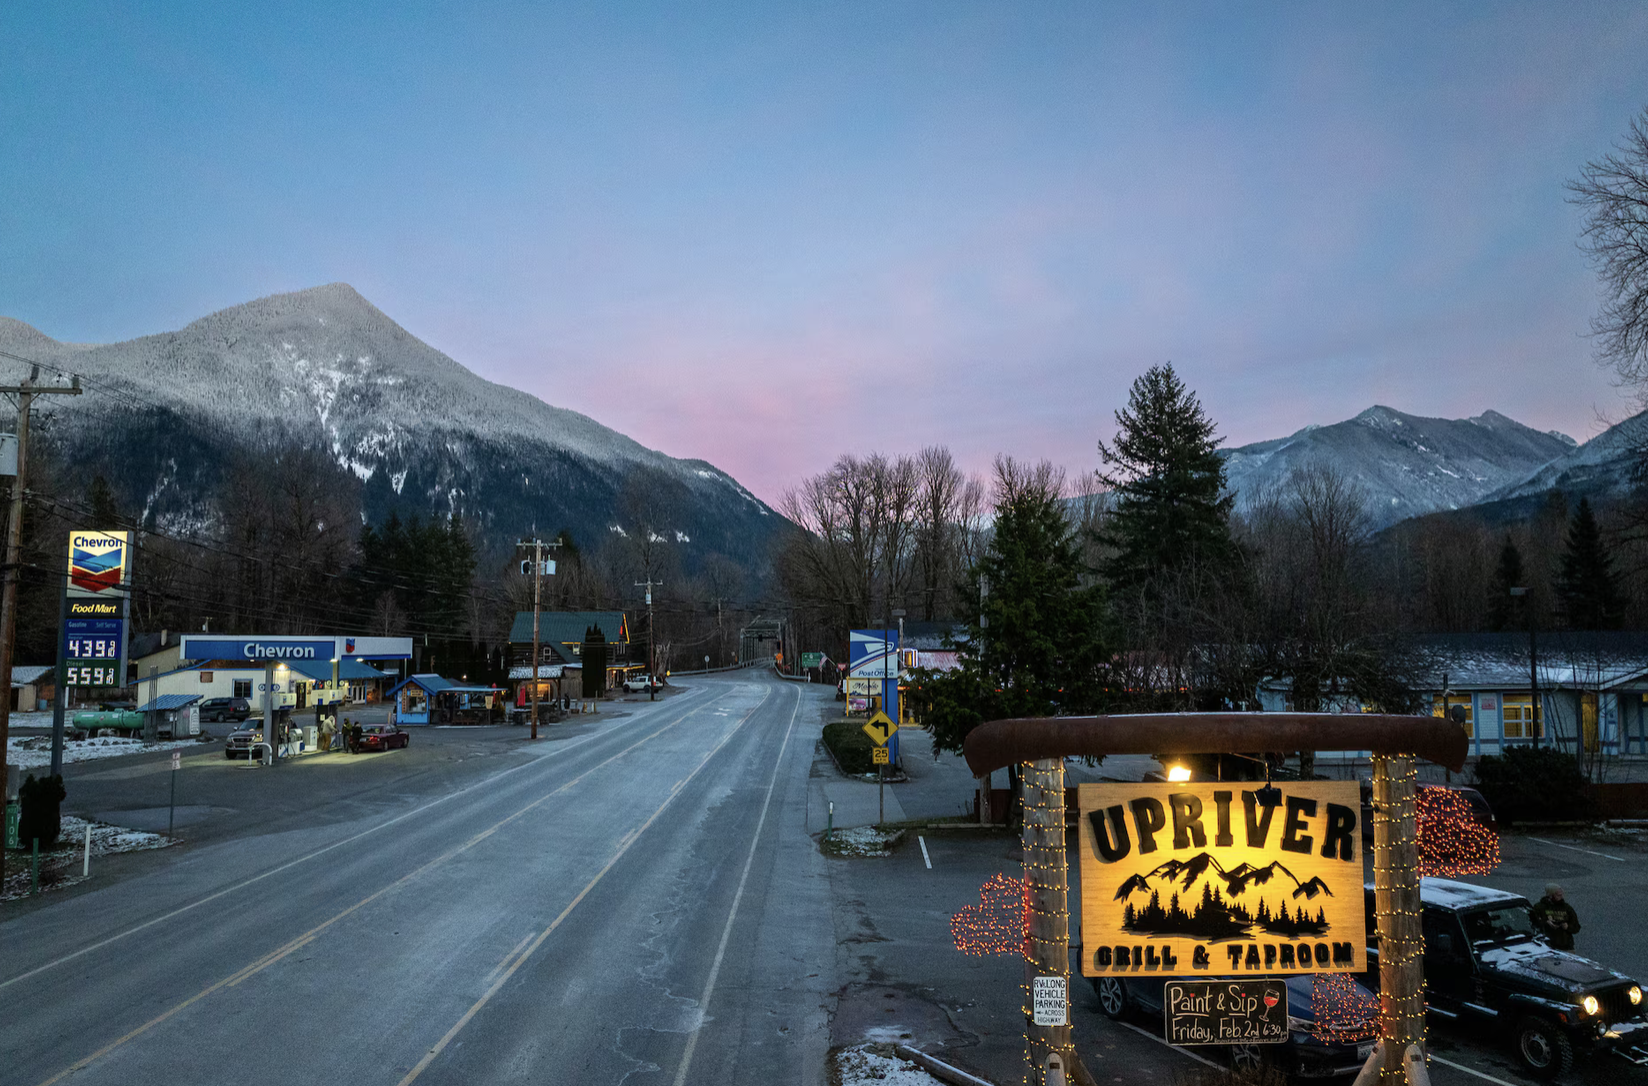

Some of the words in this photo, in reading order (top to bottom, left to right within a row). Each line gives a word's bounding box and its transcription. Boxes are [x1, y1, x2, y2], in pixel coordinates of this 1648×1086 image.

[73, 536, 122, 547] Chevron
[71, 603, 94, 613] Food
[94, 604, 117, 613] Mart
[243, 643, 315, 659] Chevron
[875, 749, 888, 758] 25
[1088, 790, 1357, 863] UPRIVER
[1096, 945, 1177, 968] GRILL
[1193, 945, 1211, 967] &
[1227, 942, 1353, 967] TAPROOM
[1034, 989, 1065, 999] VEHICLE
[1035, 999, 1065, 1009] PARKING
[1170, 986, 1213, 1014] Paint
[1216, 993, 1226, 1011] &
[1228, 984, 1259, 1018] Sip
[1172, 1016, 1214, 1043] Friday,
[1219, 1017, 1242, 1039] Feb.
[1244, 1020, 1260, 1038] 2nd
